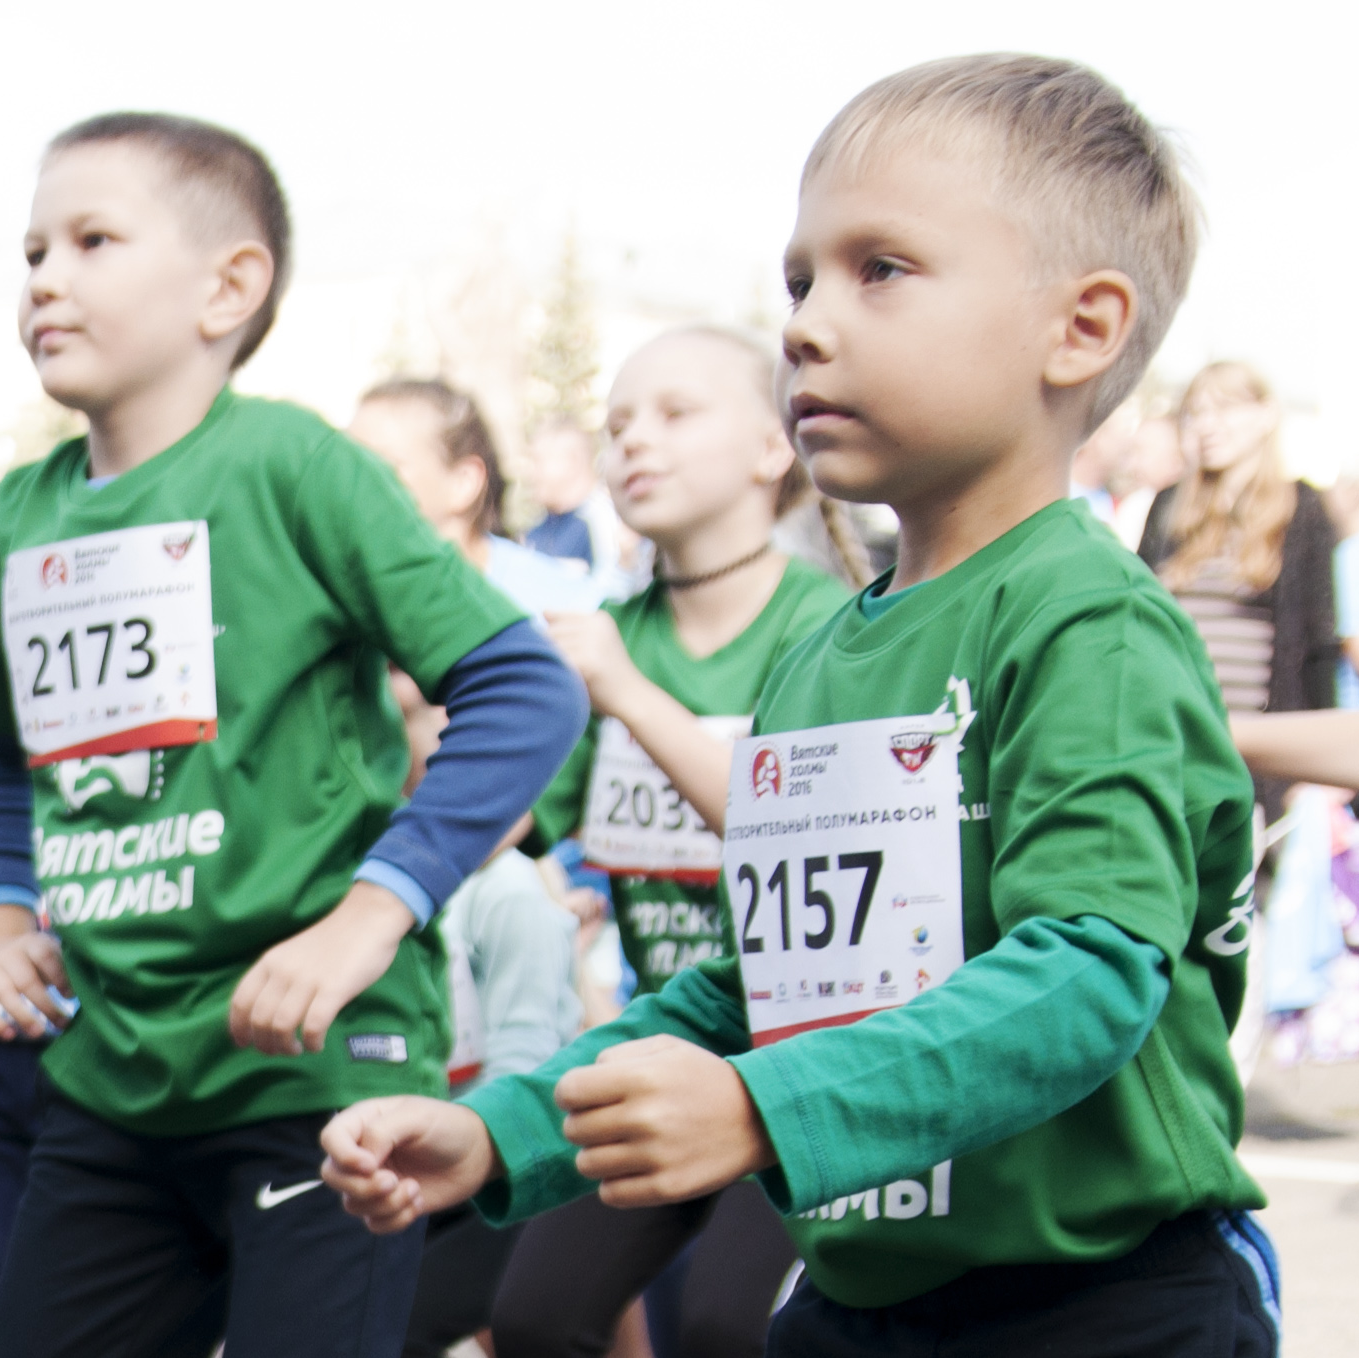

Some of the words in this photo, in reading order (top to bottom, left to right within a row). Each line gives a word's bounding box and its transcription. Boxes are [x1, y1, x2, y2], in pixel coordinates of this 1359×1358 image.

[100, 582, 196, 607] ПОЛУМАРАФОН
[27, 616, 156, 697] 2173
[790, 742, 839, 762] Вятские
[789, 761, 828, 778] холмы
[788, 779, 813, 798] 2016
[815, 804, 937, 832] ПОЛУМАРАФОН
[737, 849, 885, 955] 2157
